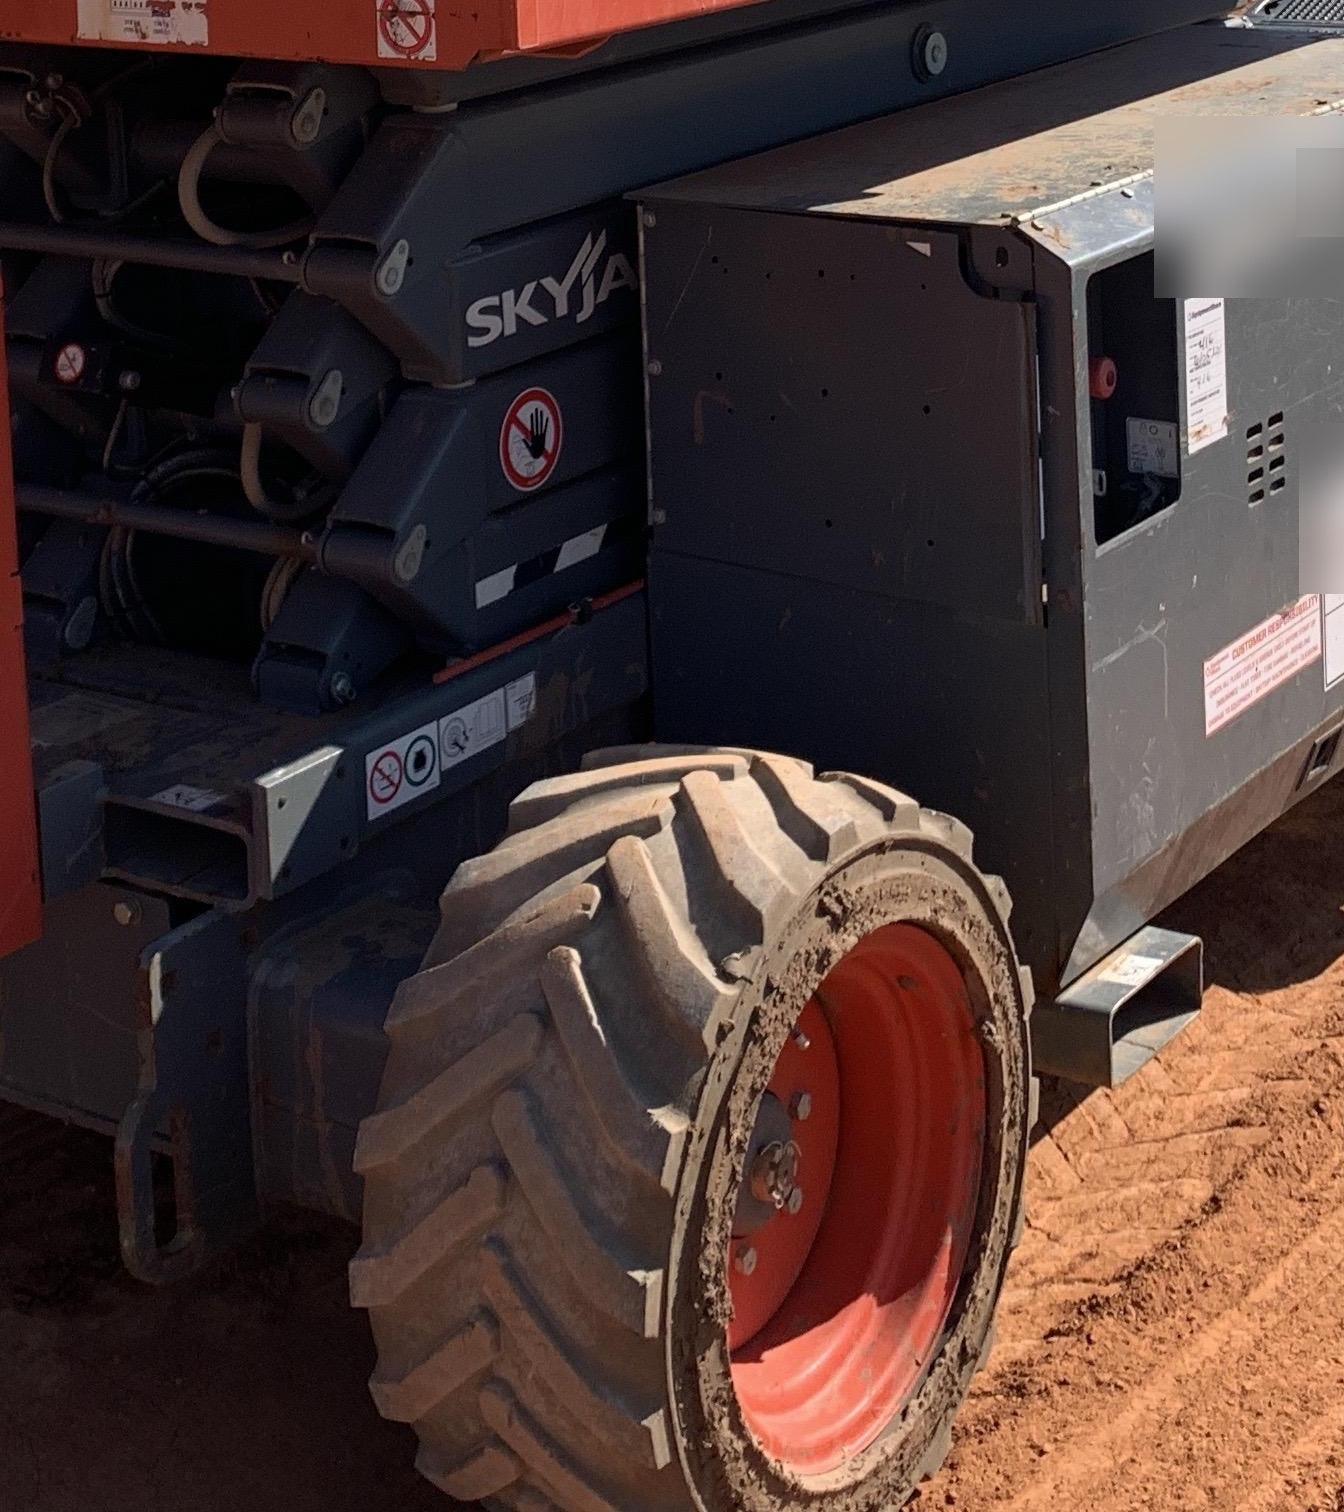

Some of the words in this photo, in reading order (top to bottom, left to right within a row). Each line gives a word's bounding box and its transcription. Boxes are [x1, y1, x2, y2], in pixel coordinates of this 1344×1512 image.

[466, 228, 638, 348] SKYJA
[1232, 628, 1268, 661] CUSTOMER
[1268, 594, 1319, 634] RESPSIBILITY
